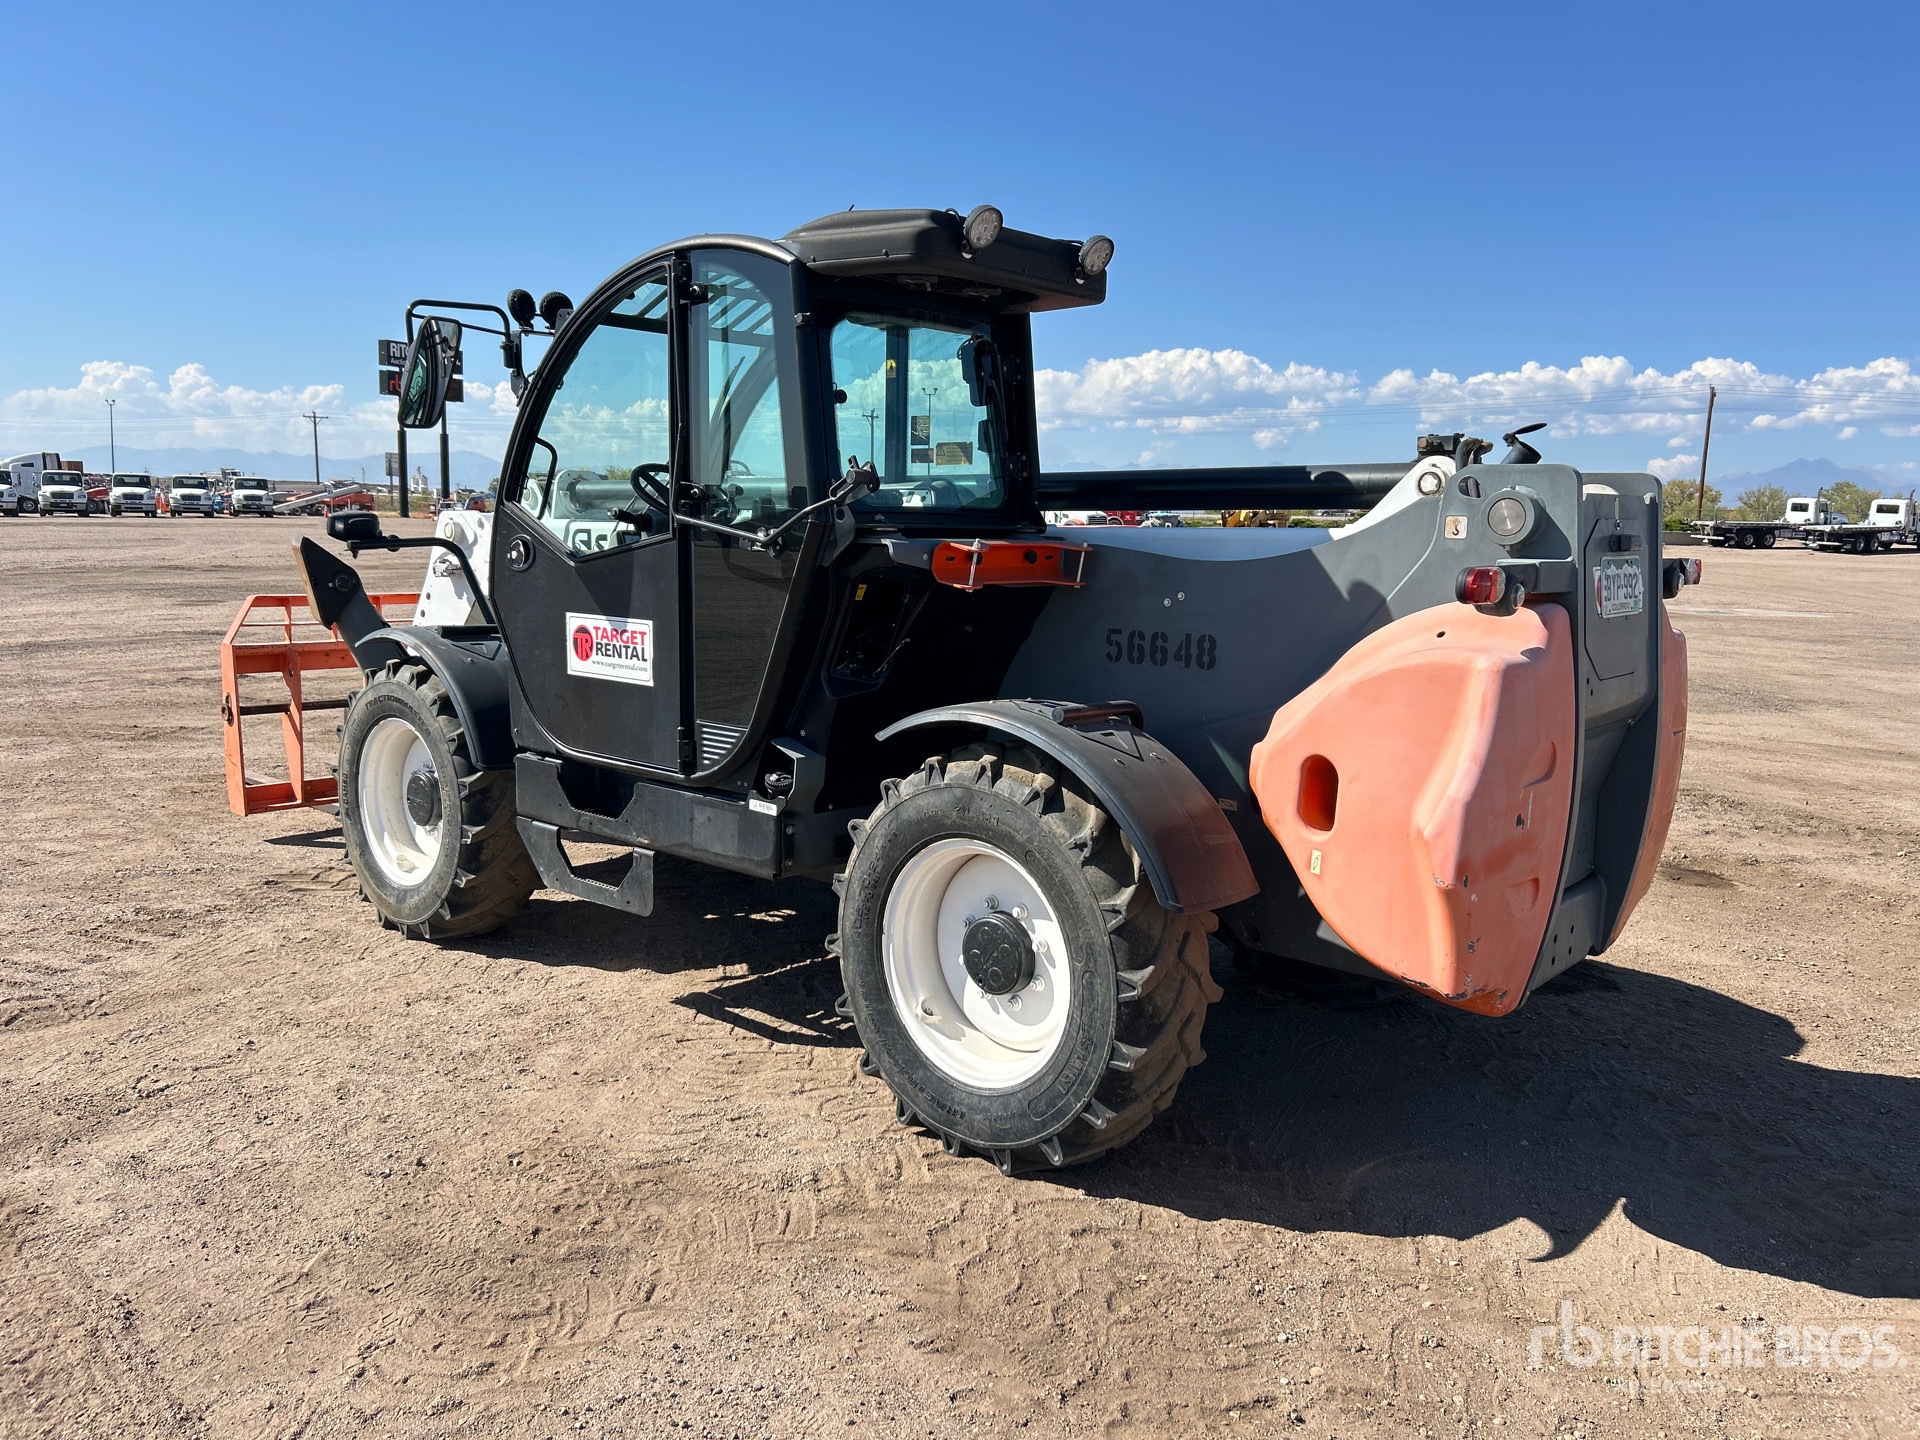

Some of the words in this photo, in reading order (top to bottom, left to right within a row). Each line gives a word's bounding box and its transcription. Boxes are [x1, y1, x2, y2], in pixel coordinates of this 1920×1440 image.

[593, 626, 647, 646] TARGET
[595, 641, 648, 662] RENTAL
[1105, 628, 1217, 671] 56648
[592, 660, 648, 672] www.targetrental.com
